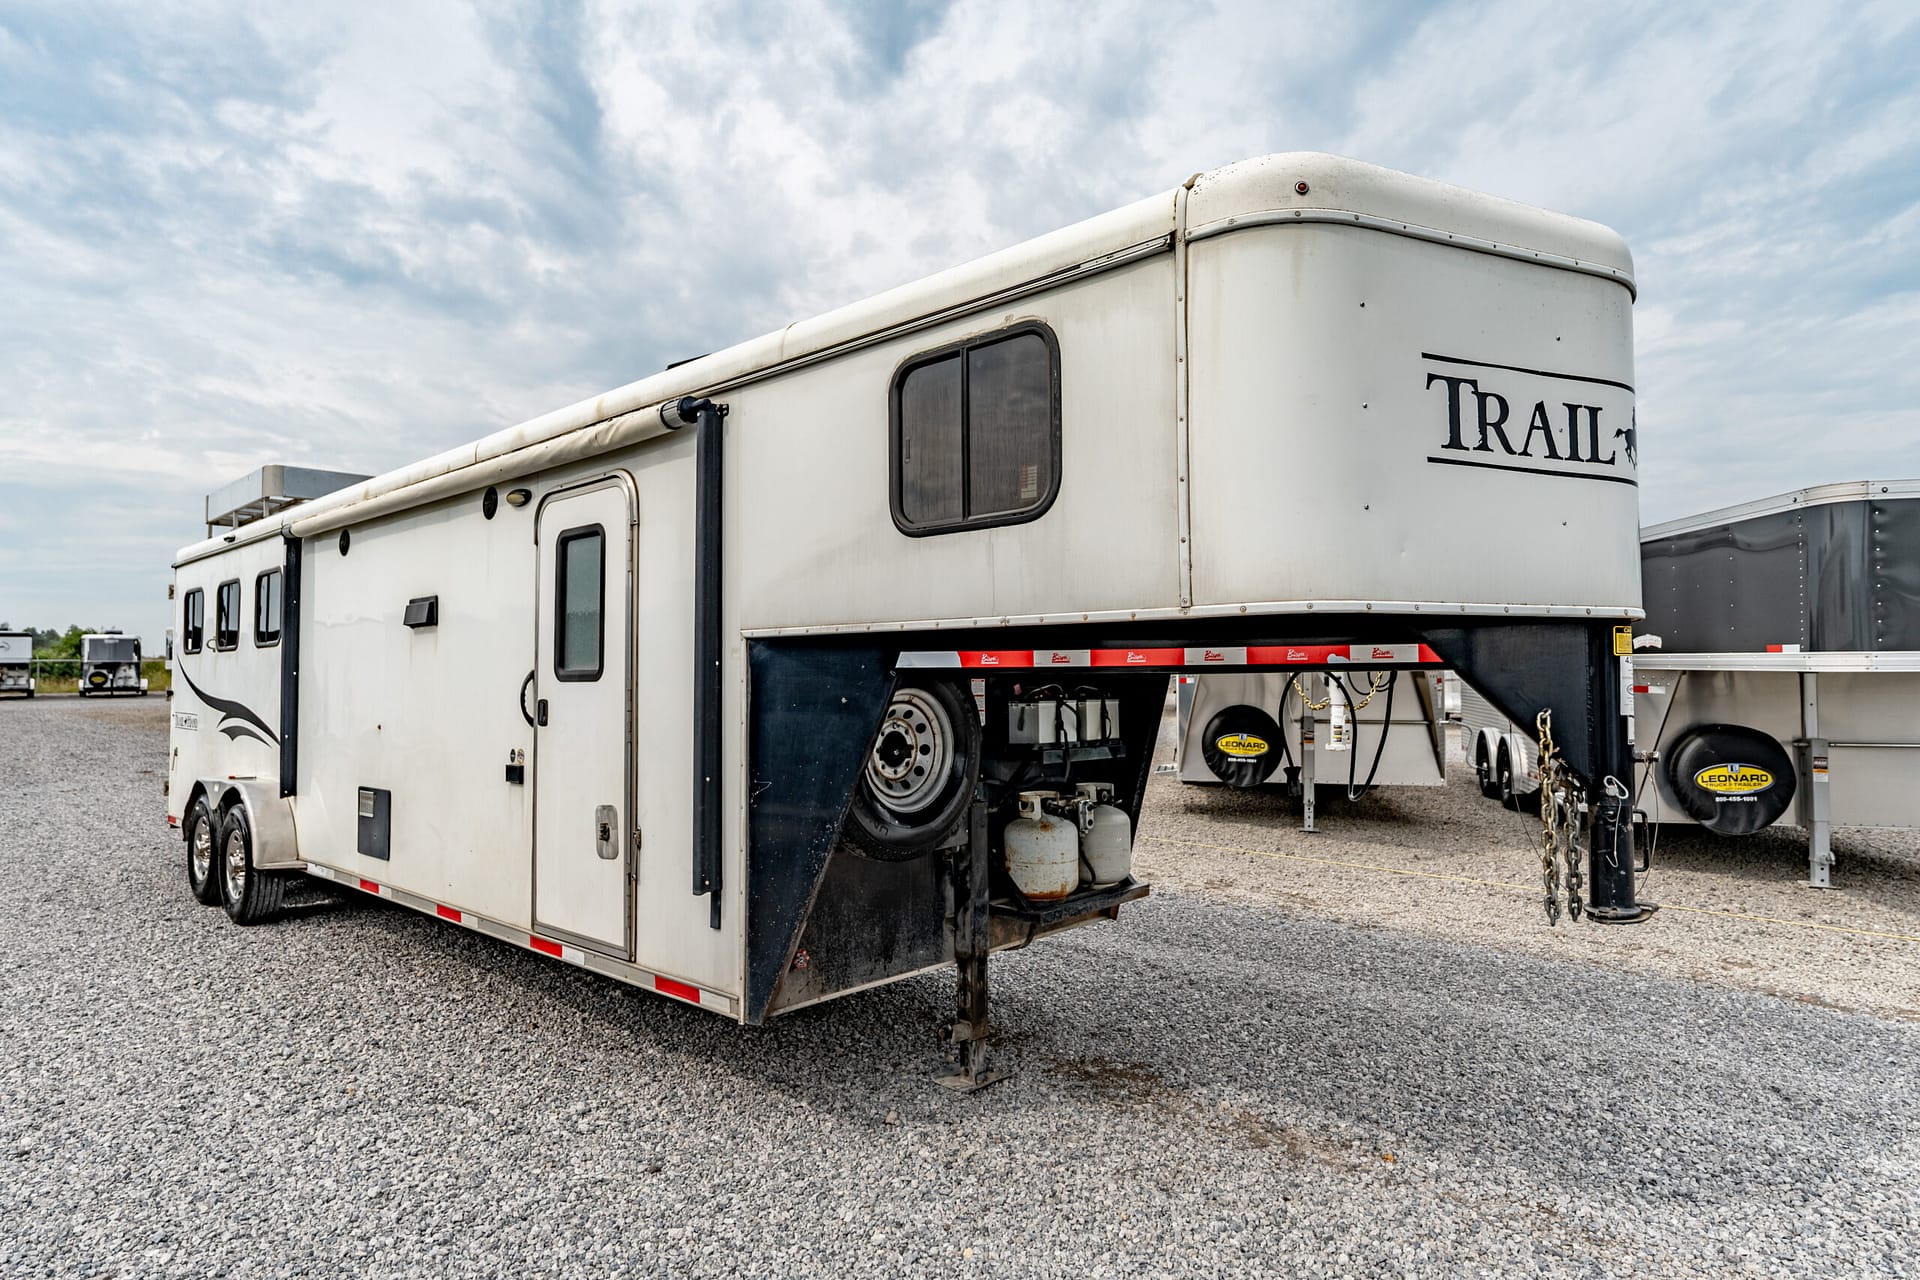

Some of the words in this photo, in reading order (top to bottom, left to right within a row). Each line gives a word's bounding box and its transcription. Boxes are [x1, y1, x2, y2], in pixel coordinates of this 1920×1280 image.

[1426, 372, 1616, 466] TRAIL
[1220, 741, 1266, 749] LEONARD
[1701, 774, 1769, 783] LEONARD
